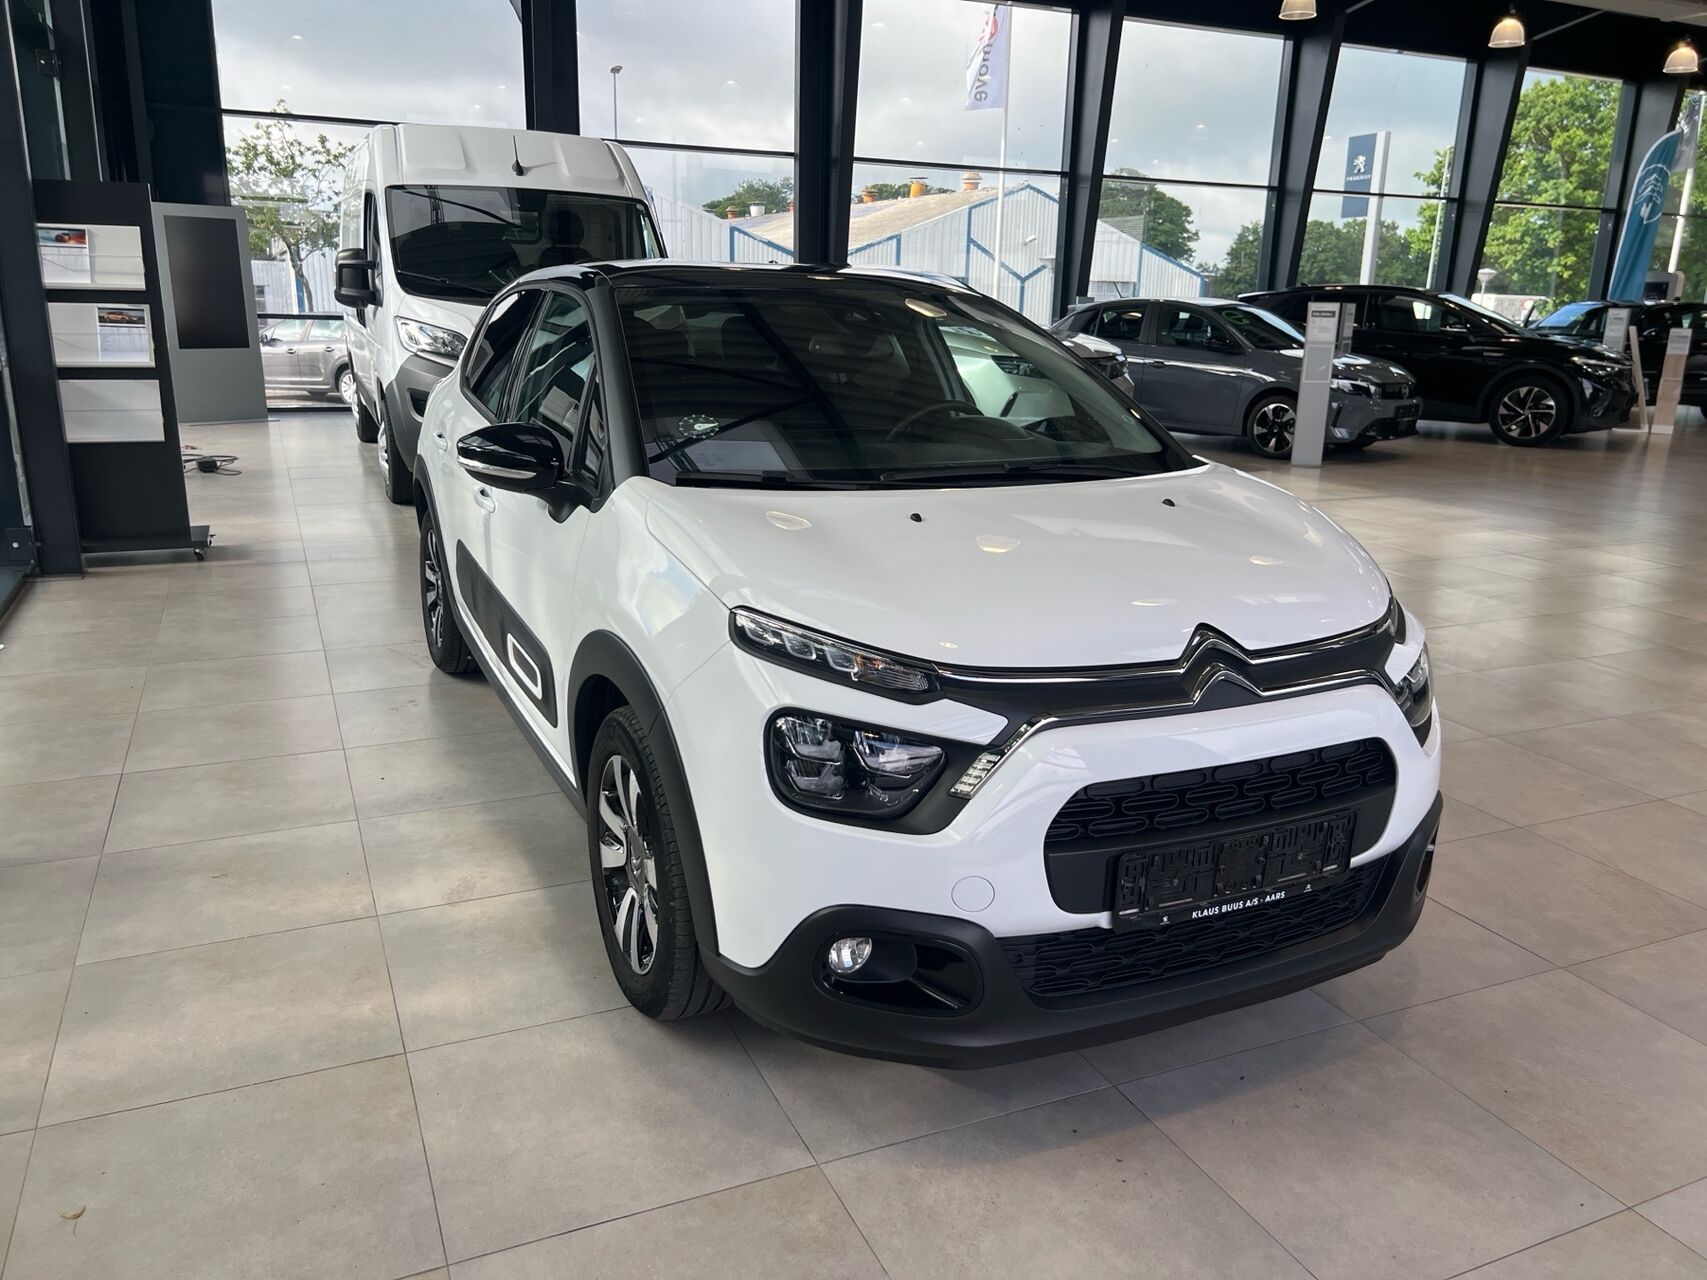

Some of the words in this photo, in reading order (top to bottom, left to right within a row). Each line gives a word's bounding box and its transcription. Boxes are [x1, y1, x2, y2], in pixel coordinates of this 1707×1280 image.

[1192, 906, 1220, 919] KLAUS
[1221, 900, 1244, 912] BUUS
[1245, 897, 1259, 907] A/S
[1264, 890, 1286, 902] AARS
